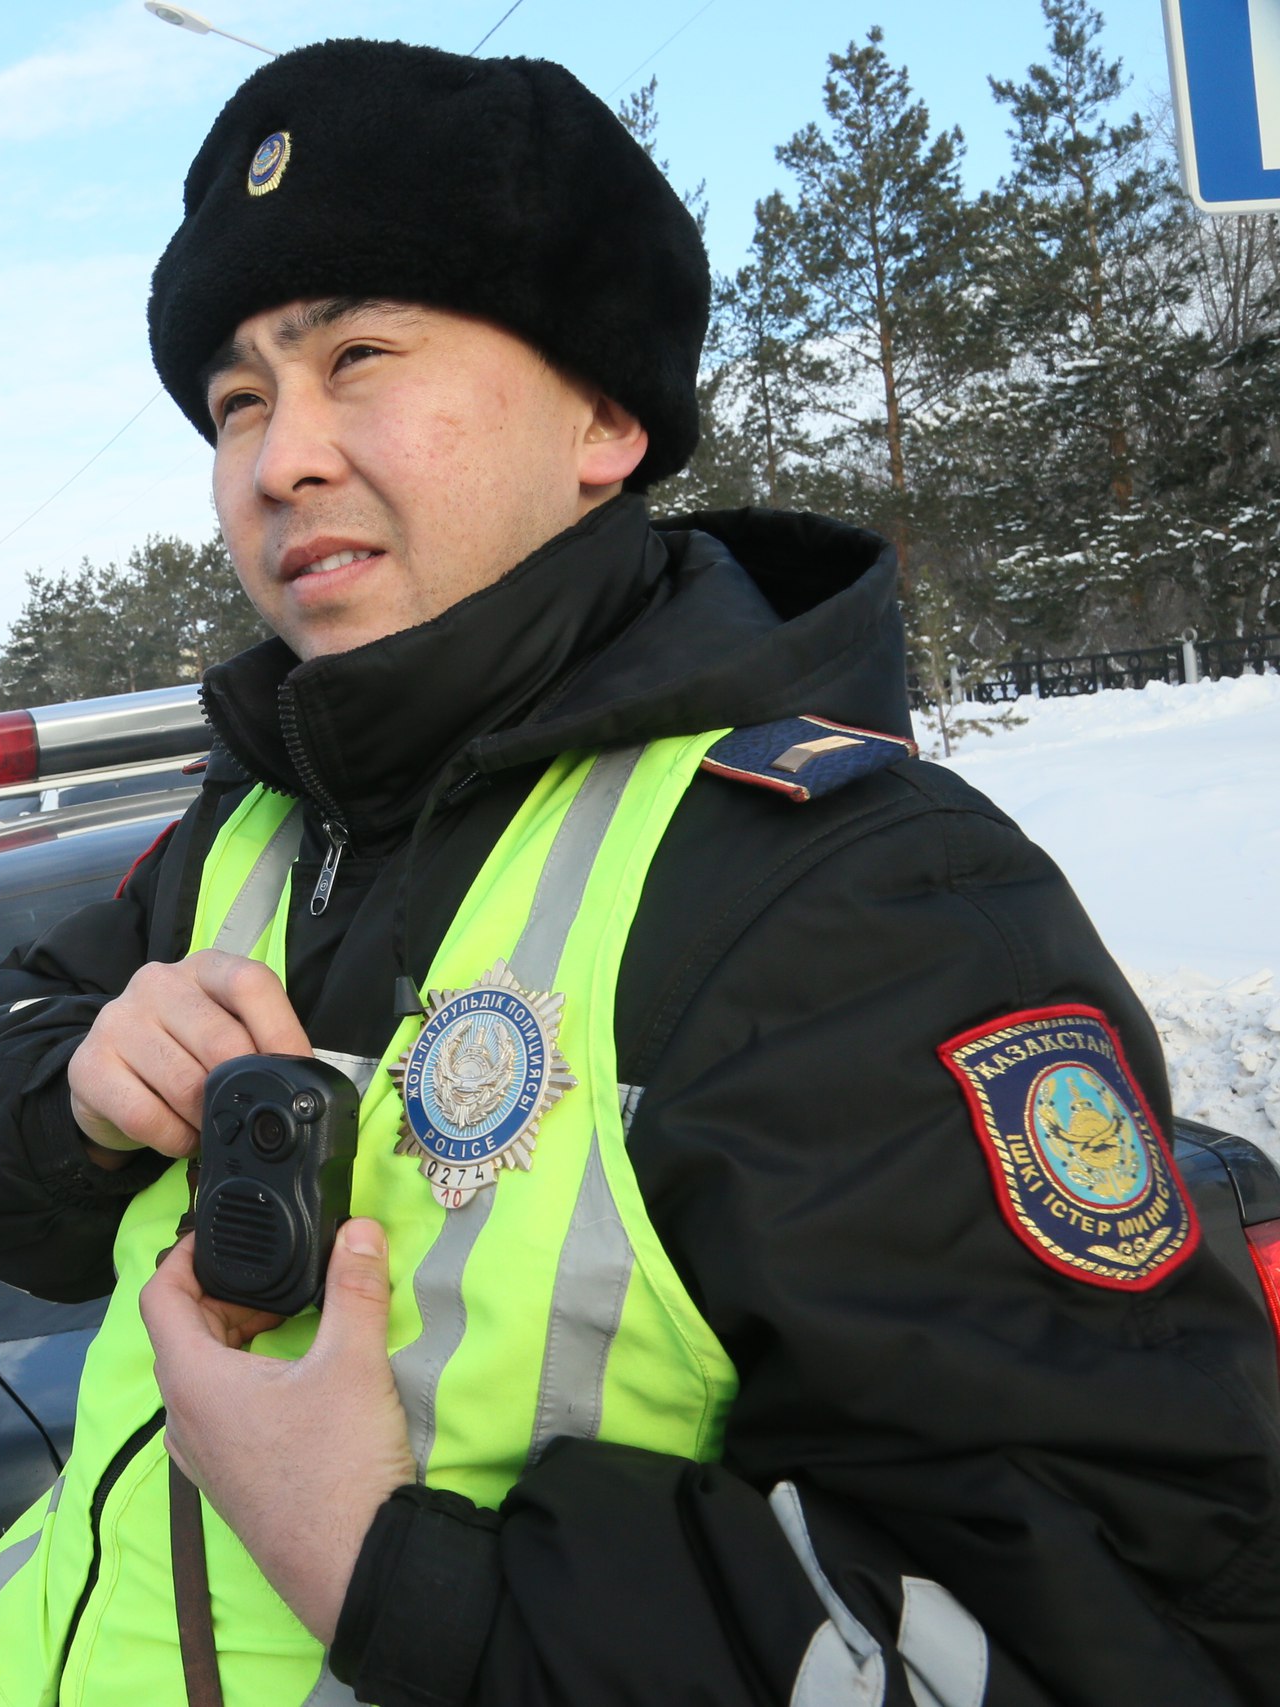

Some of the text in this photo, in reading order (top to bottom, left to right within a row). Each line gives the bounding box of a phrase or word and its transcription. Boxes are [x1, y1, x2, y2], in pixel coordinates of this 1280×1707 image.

[408, 993, 542, 1112] ЖОЛ-ПАТРУЛЬДІК ПОЛИЦИЯСЫ
[423, 1130, 496, 1157] POLICE
[427, 1161, 485, 1186] 0274
[1006, 1134, 1044, 1193] ІШКІ
[1042, 1192, 1112, 1237] ІСТЕР
[440, 1189, 462, 1208] 10
